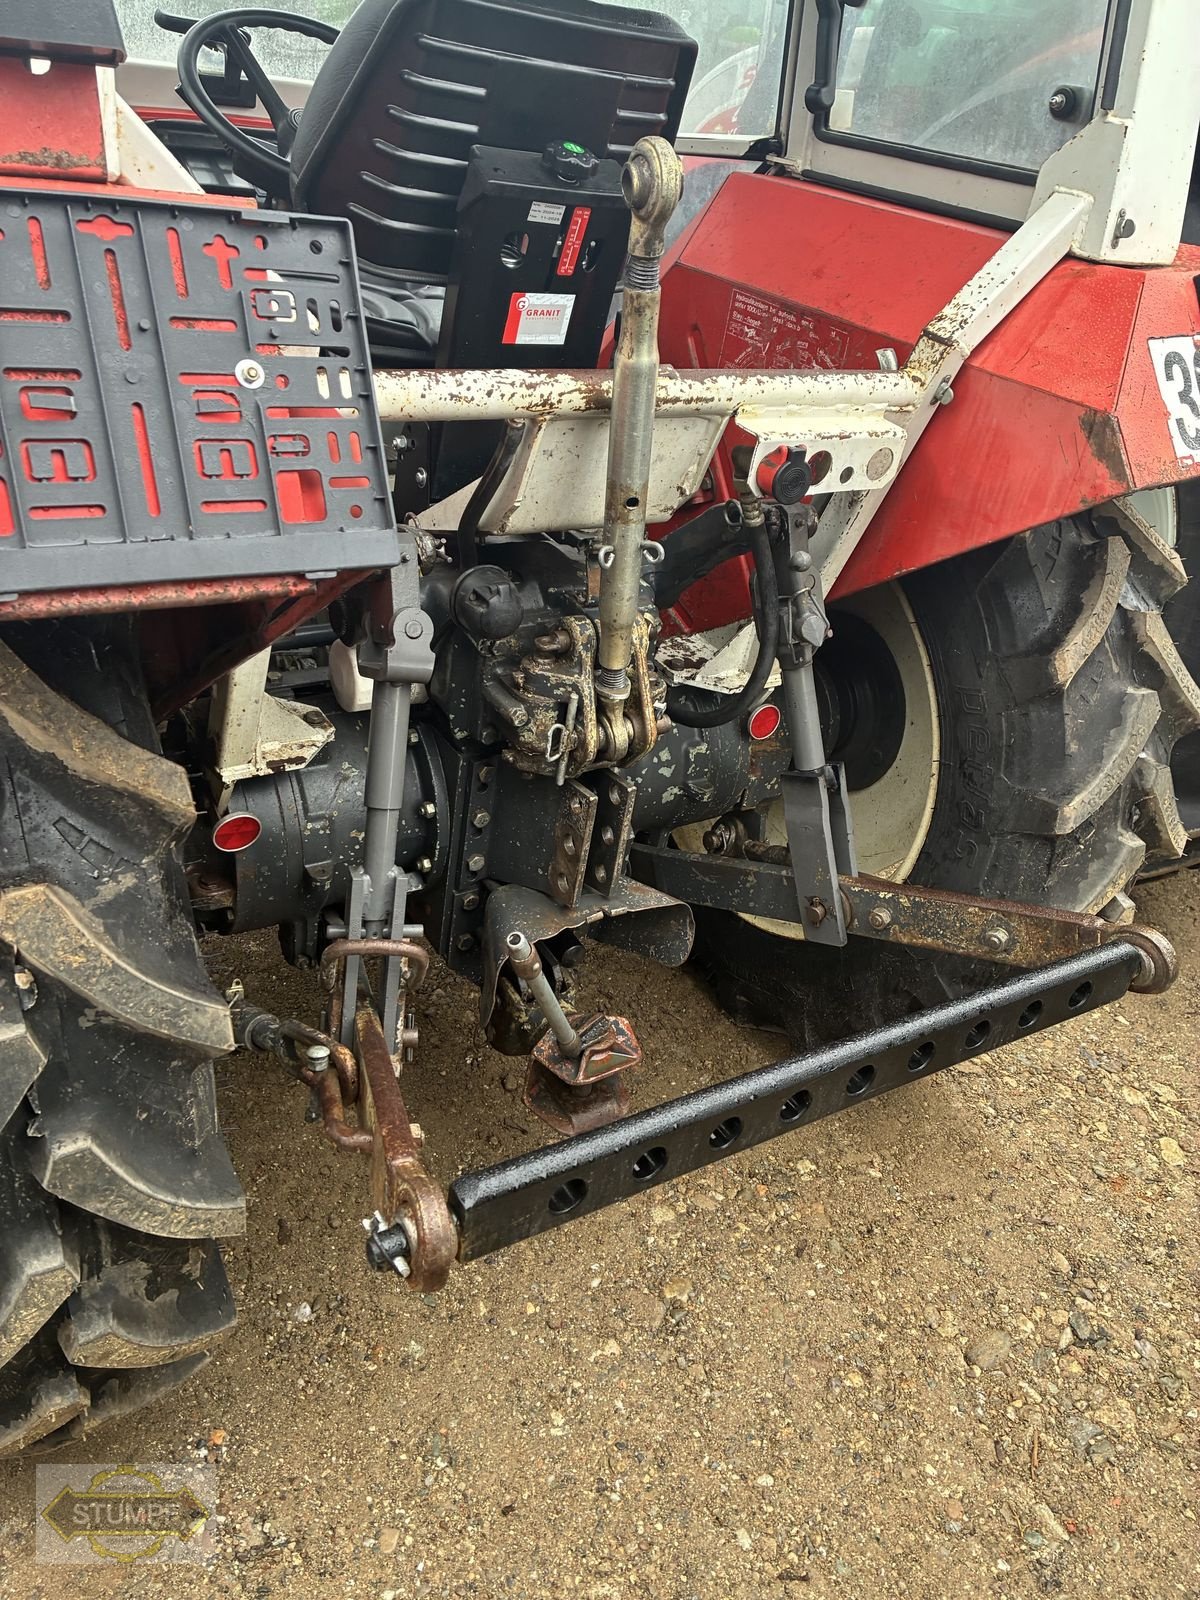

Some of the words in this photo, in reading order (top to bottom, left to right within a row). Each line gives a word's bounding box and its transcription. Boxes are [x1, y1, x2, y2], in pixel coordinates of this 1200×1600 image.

[517, 300, 526, 310] G
[526, 309, 561, 317] GRANIT
[1164, 351, 1200, 450] 3
